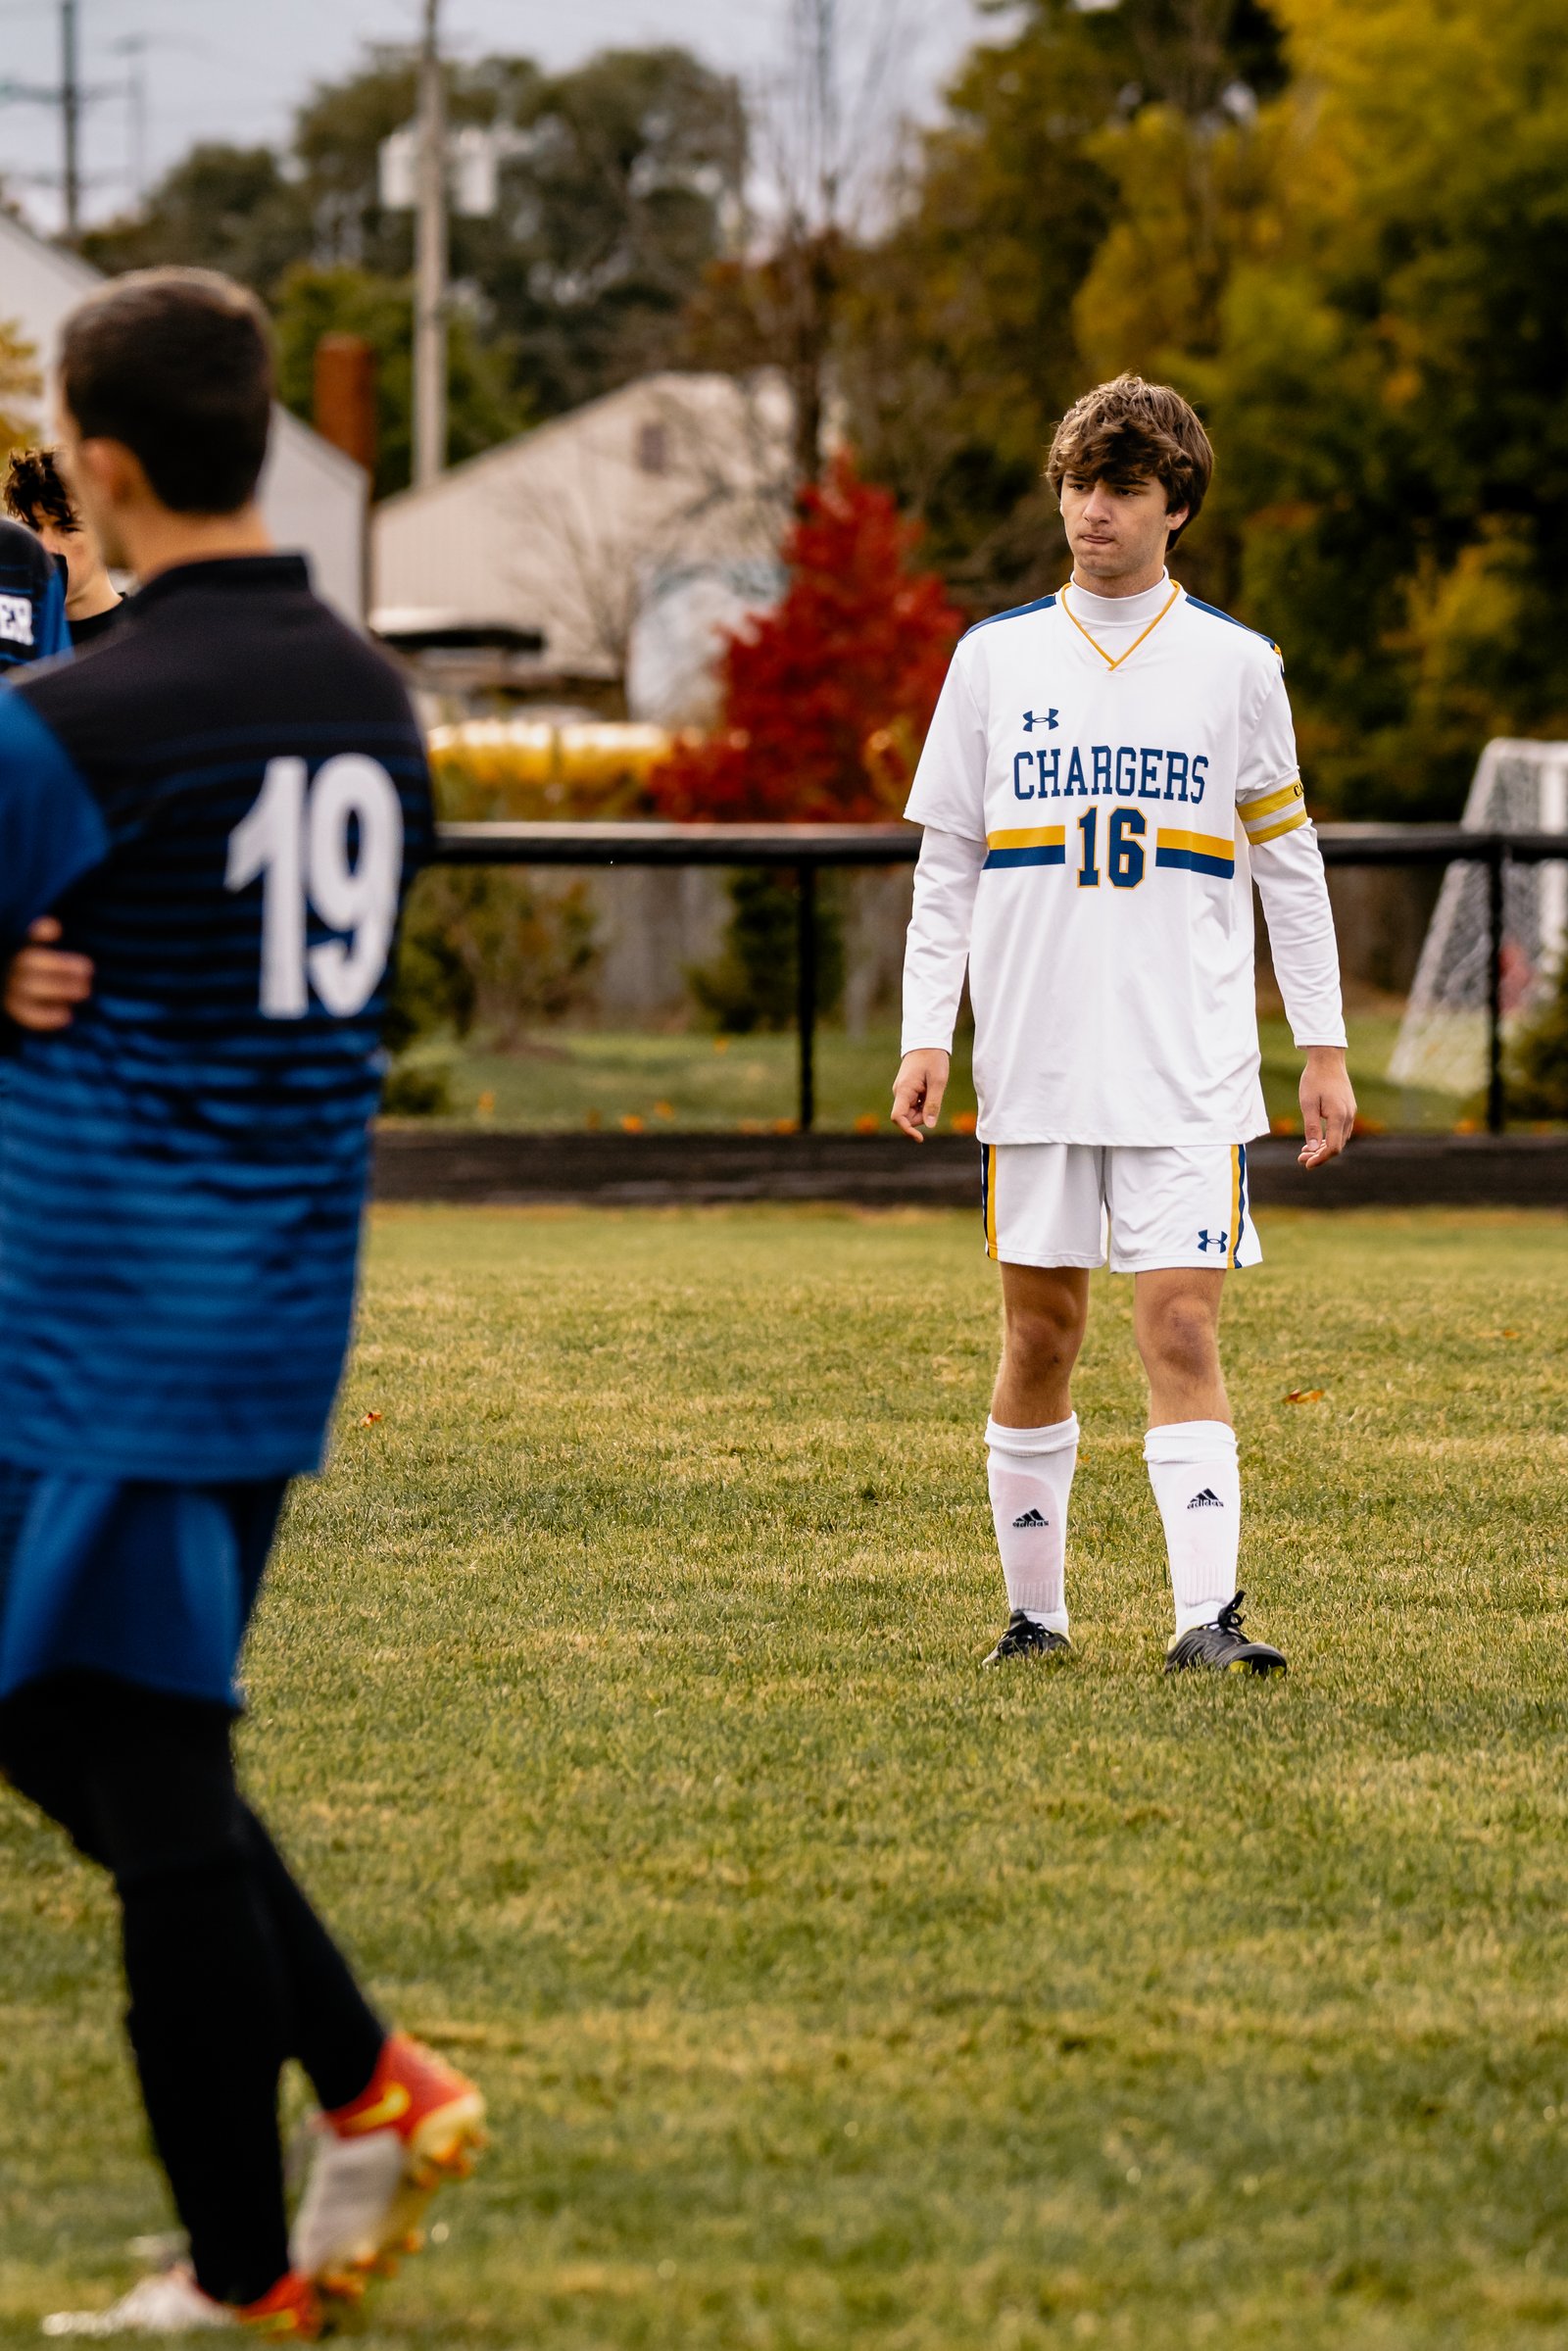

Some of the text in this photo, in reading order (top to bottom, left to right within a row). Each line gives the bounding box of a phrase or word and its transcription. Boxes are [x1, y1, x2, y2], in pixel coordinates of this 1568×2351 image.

[1013, 745, 1208, 805] CHARGERS
[223, 752, 404, 1020] 19
[1077, 805, 1148, 890] 16
